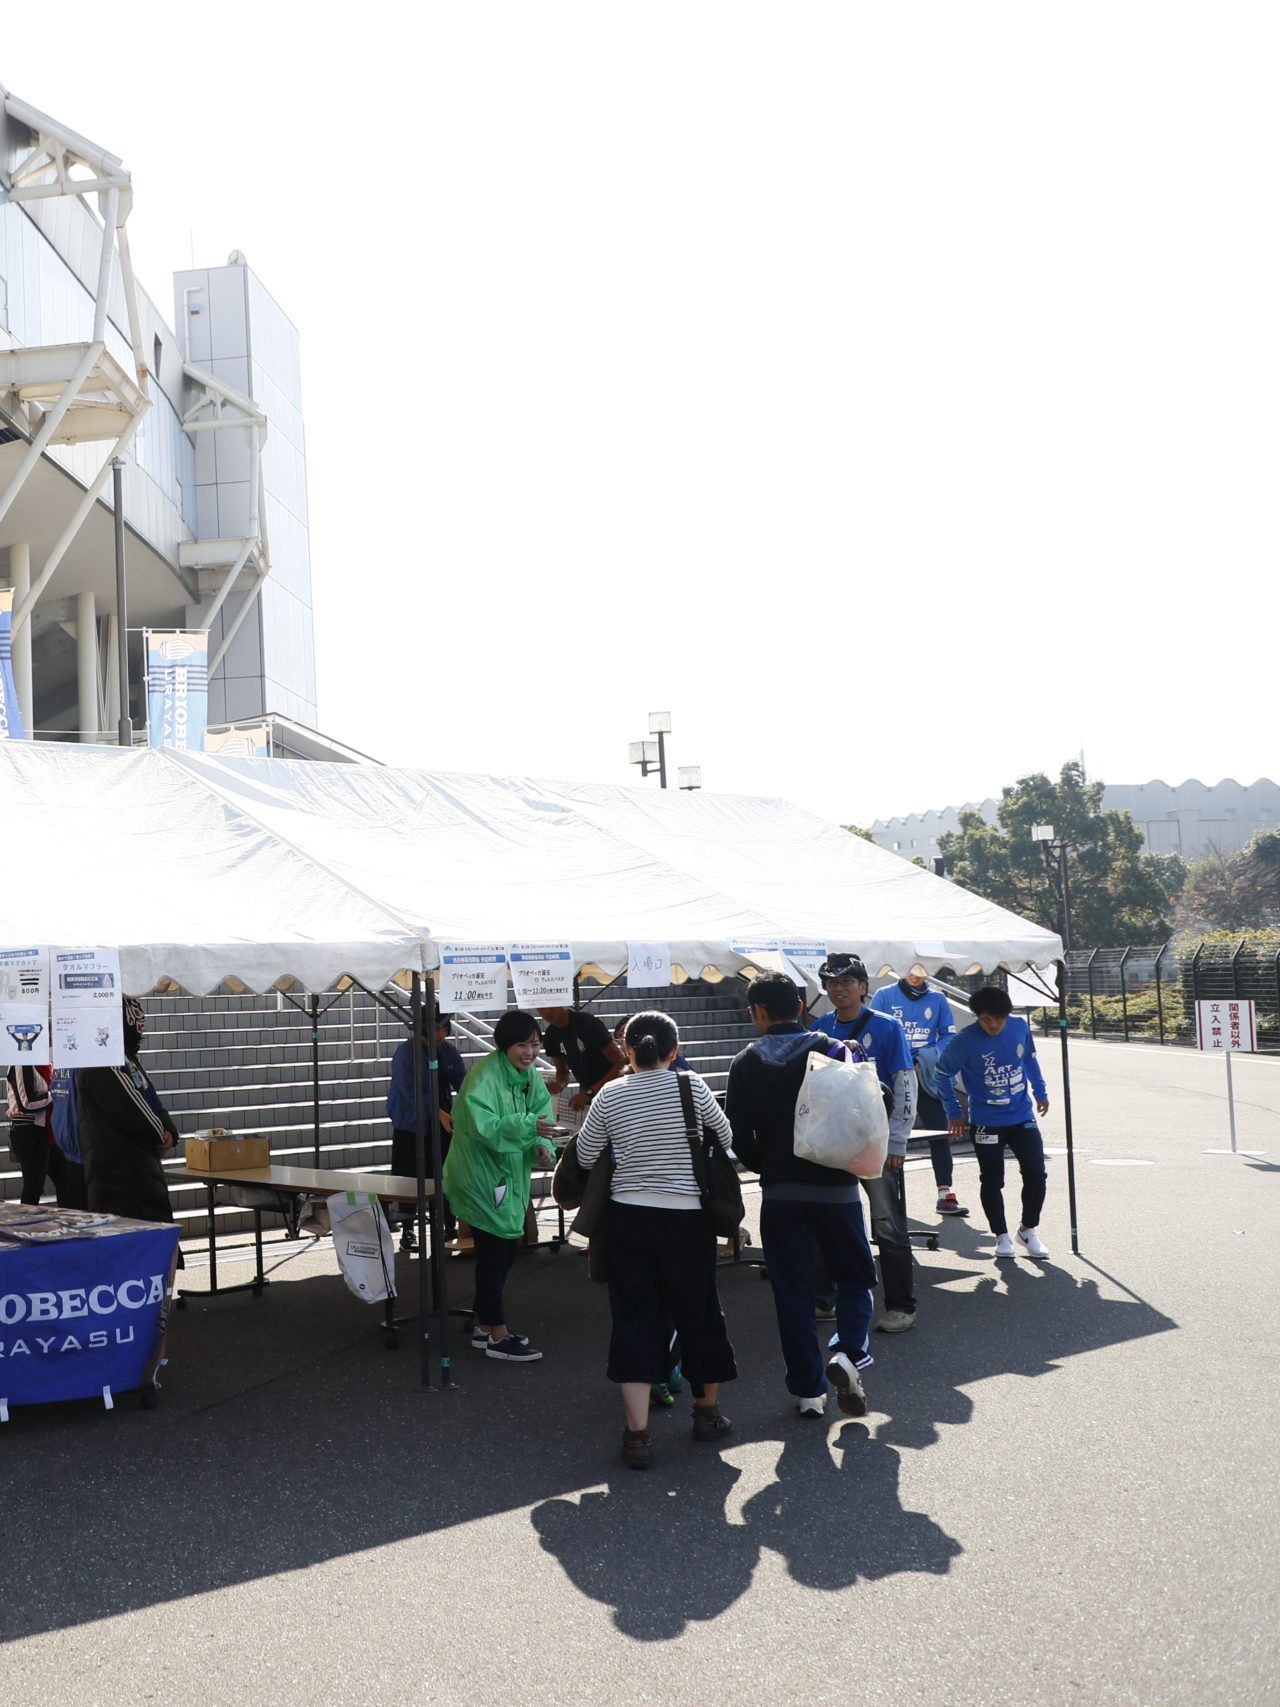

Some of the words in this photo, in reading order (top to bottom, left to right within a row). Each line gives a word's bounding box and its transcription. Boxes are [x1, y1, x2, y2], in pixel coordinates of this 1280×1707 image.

[631, 955, 663, 972] 入場口
[21, 987, 39, 995] 800円
[893, 1010, 903, 1018] 23
[1209, 1003, 1223, 1048] 立入禁止
[1228, 1003, 1241, 1049] 関係者以外
[984, 1057, 996, 1066] 22
[984, 1064, 1013, 1076] ART
